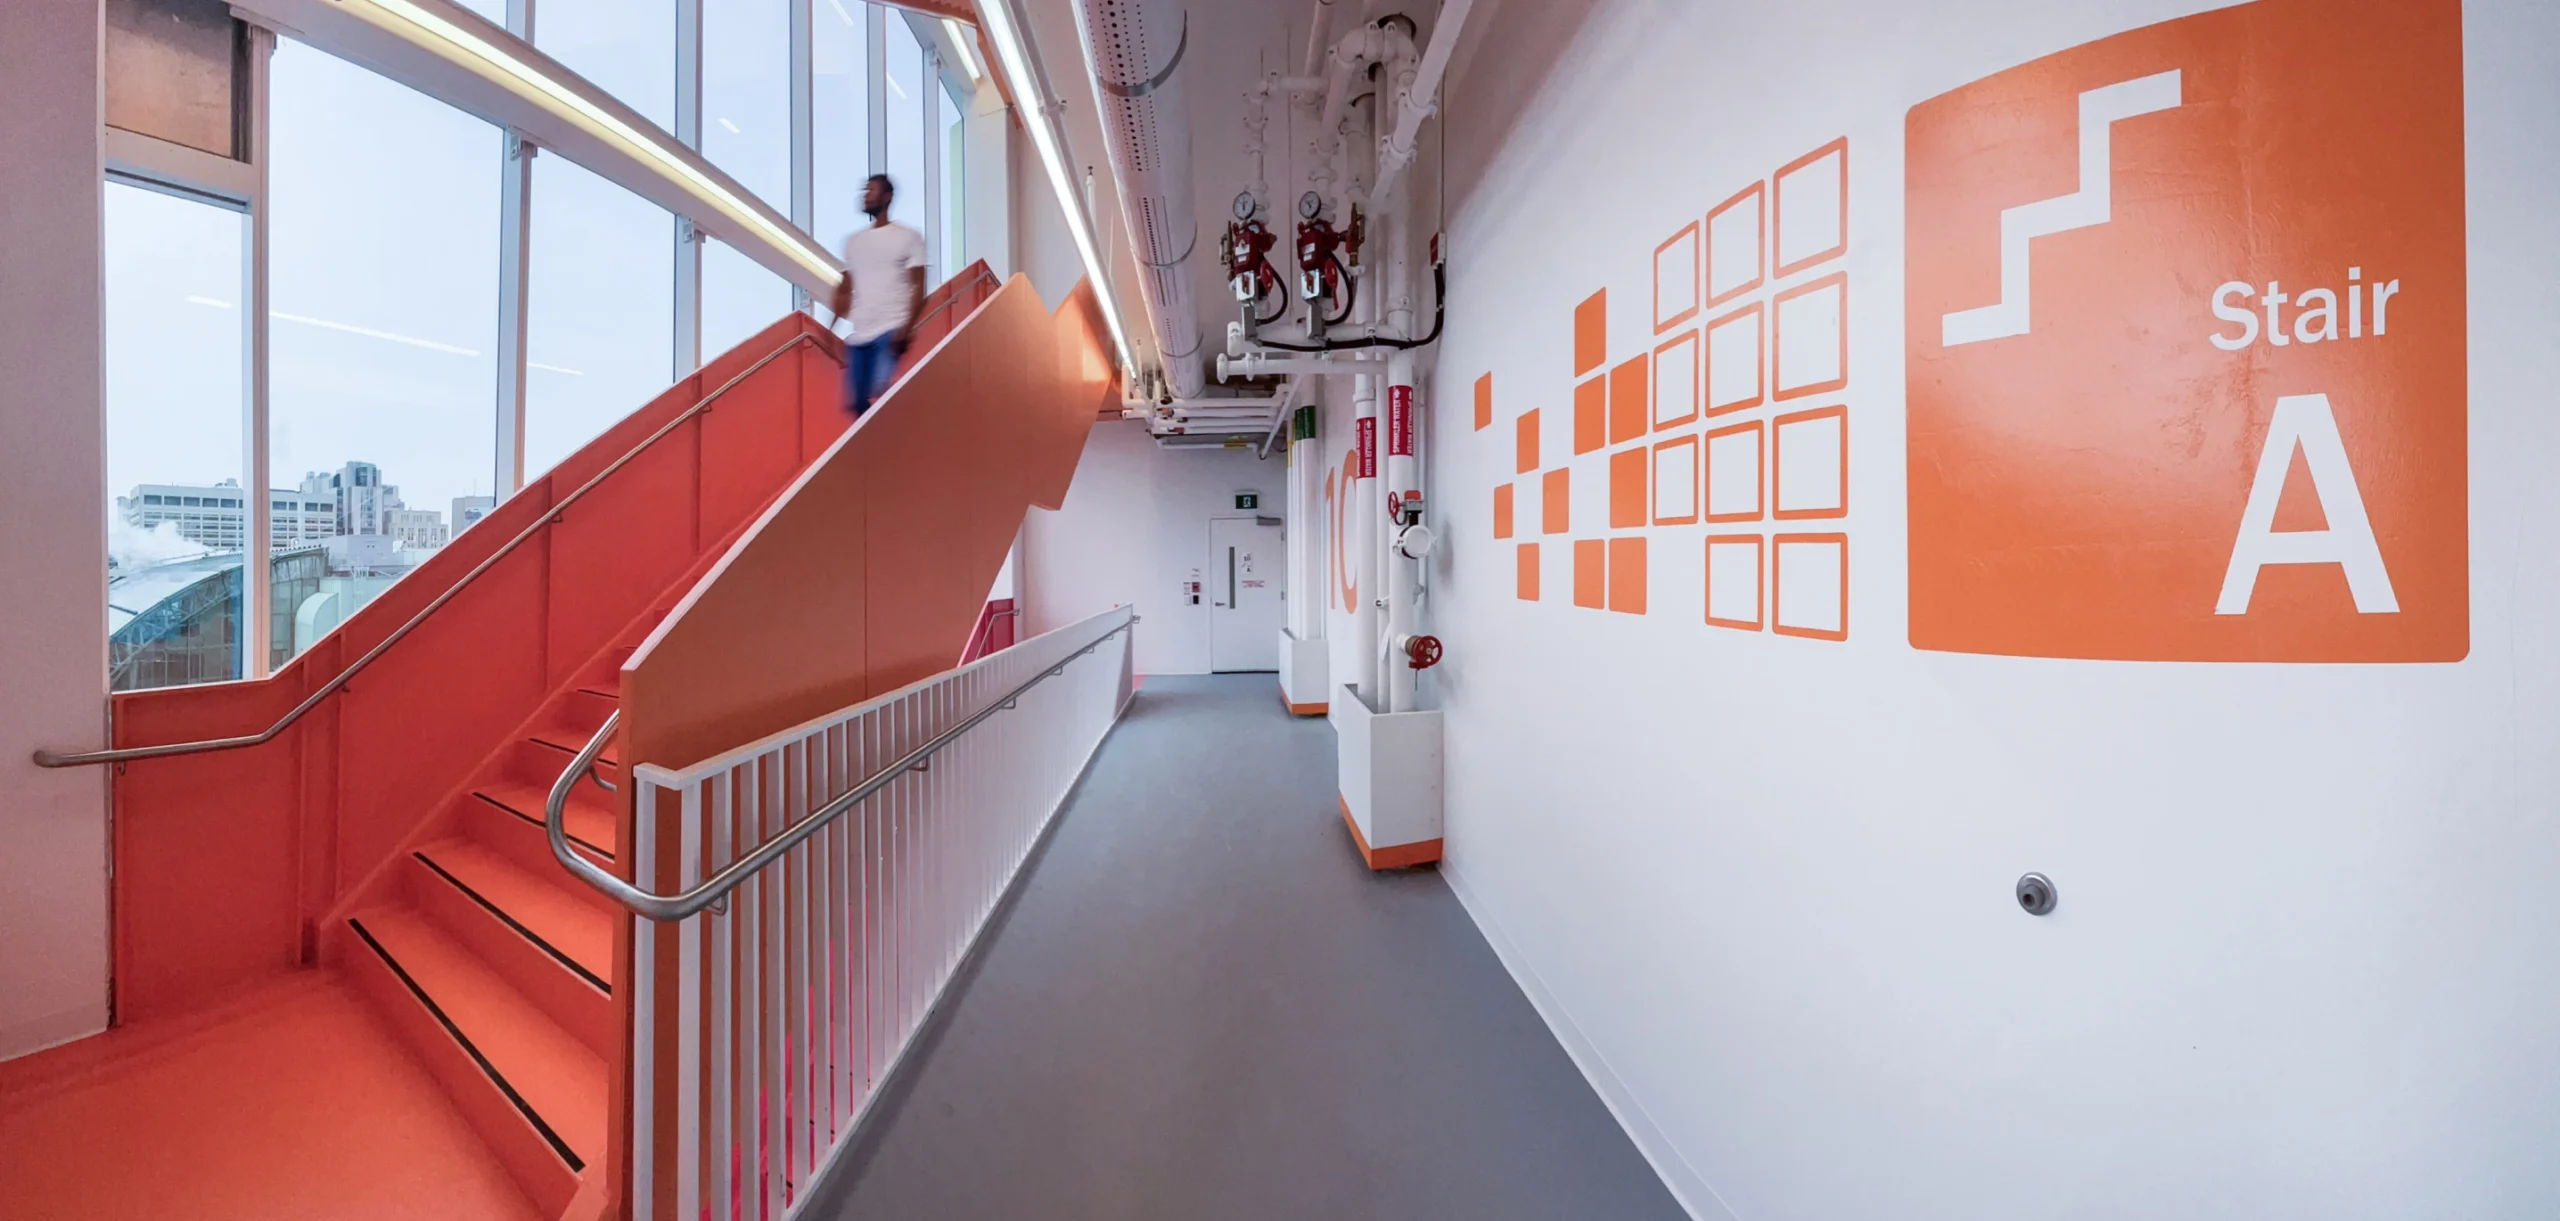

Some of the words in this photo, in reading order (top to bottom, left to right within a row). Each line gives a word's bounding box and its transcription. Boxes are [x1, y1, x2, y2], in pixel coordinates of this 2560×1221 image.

[2208, 266, 2399, 352] Stair
[1392, 399, 1401, 419] WATER
[1392, 420, 1401, 454] SPRINKLER
[2213, 393, 2401, 615] A
